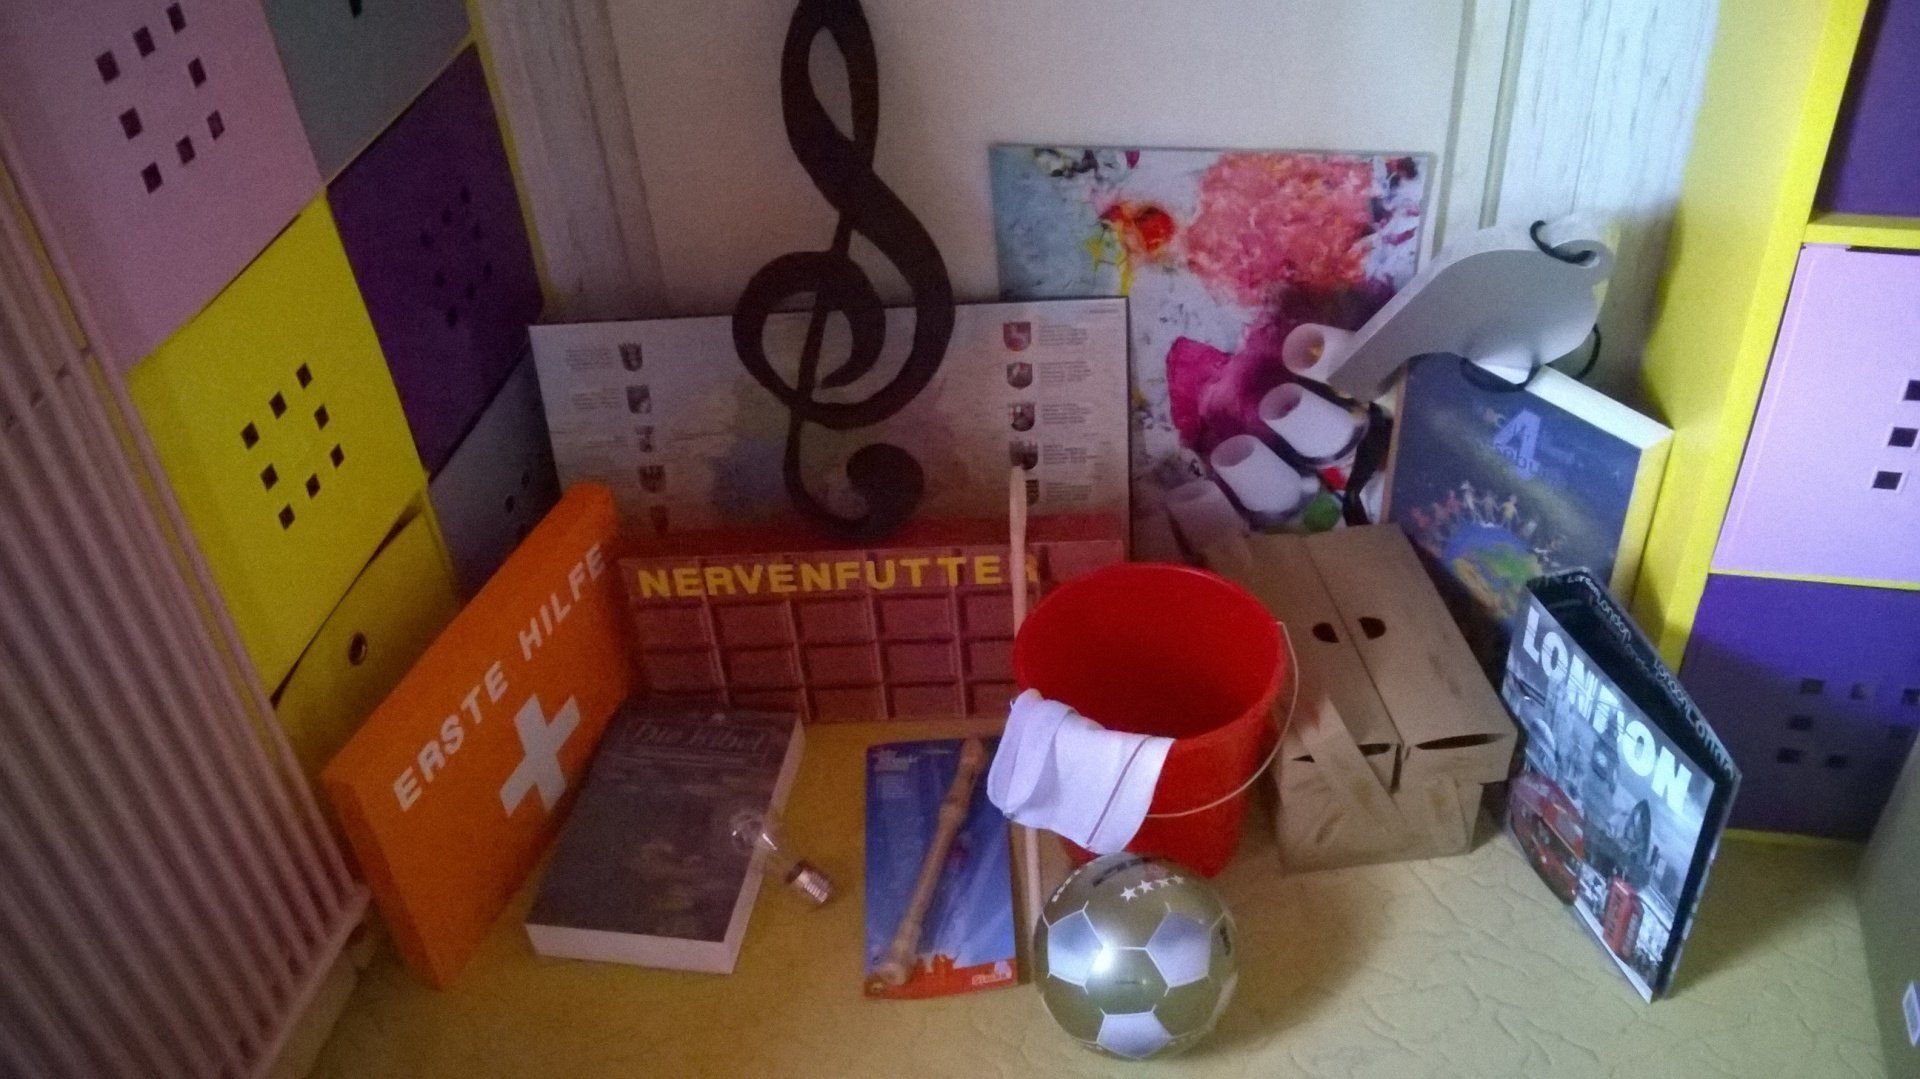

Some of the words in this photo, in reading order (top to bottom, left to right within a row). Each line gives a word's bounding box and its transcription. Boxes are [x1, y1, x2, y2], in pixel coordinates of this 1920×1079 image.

[393, 660, 508, 812] ERSTE
[519, 543, 605, 662] HILFE
[1522, 605, 1692, 817] LONDON
